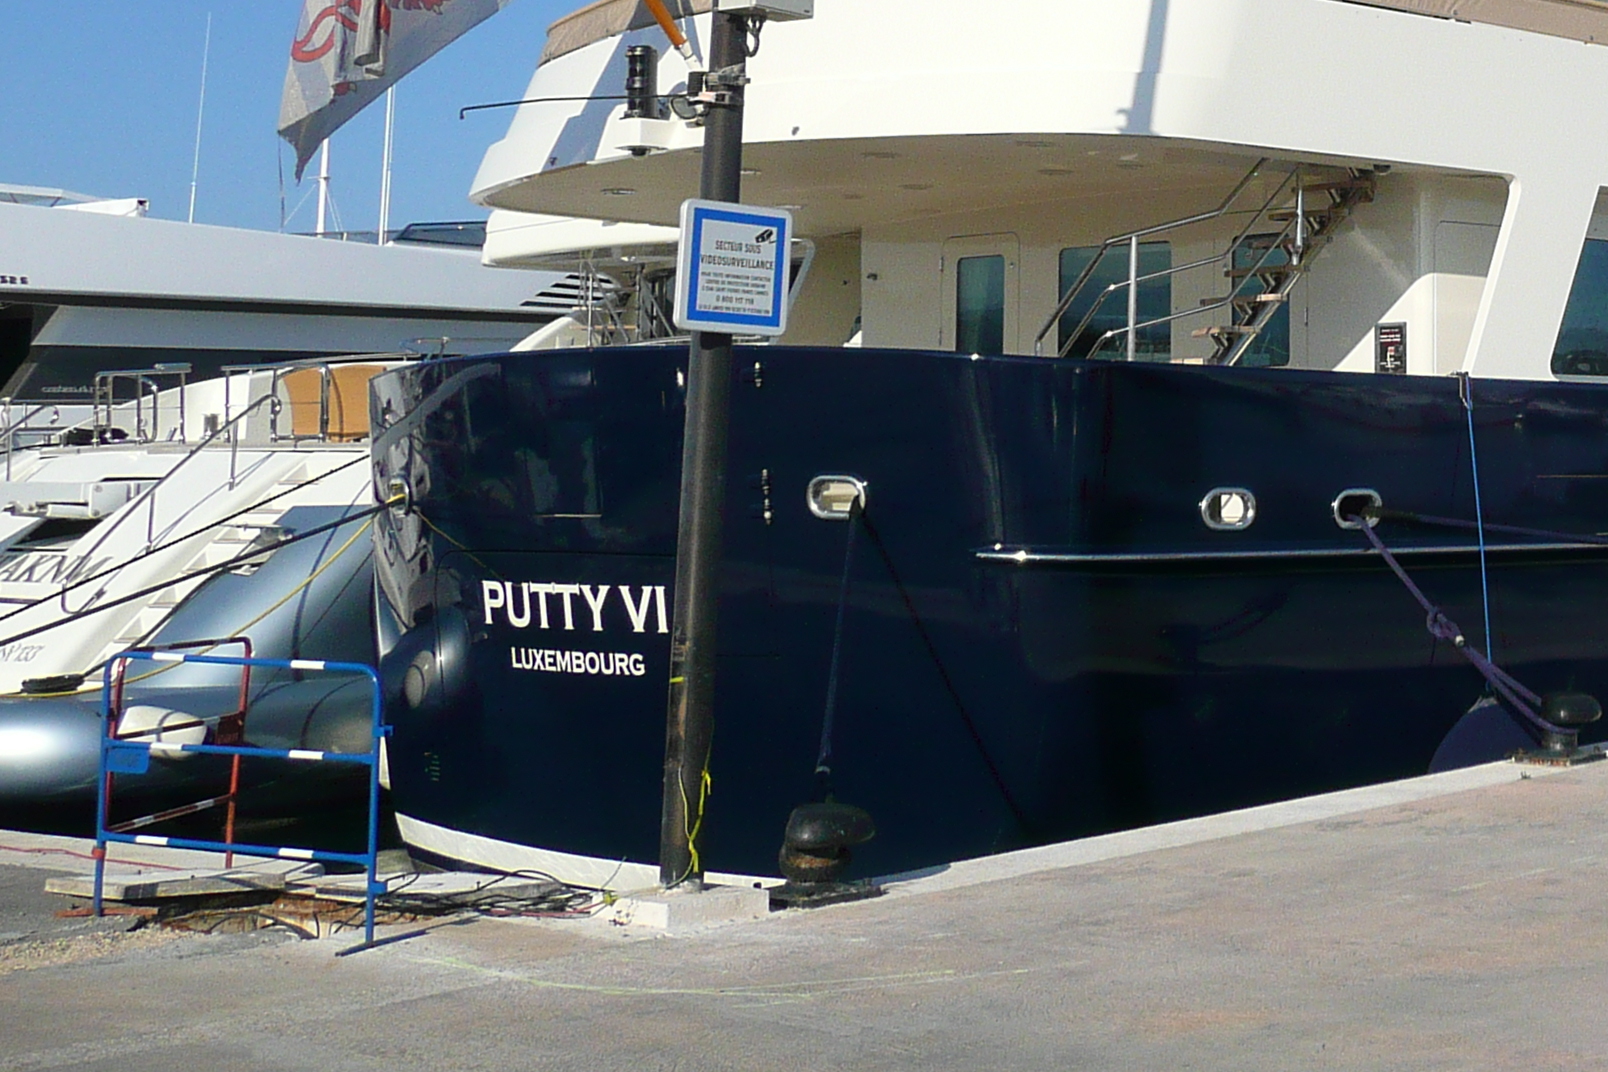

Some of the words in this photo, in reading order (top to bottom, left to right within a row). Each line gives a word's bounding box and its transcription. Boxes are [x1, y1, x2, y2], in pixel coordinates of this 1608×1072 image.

[715, 239, 743, 252] SECTEUR
[744, 243, 762, 255] SOUS
[700, 253, 774, 271] VIDEOSURVEILLANCE
[482, 580, 611, 632] PUTTY
[618, 585, 669, 633] VI
[511, 646, 646, 676] LUXEMBOURG
